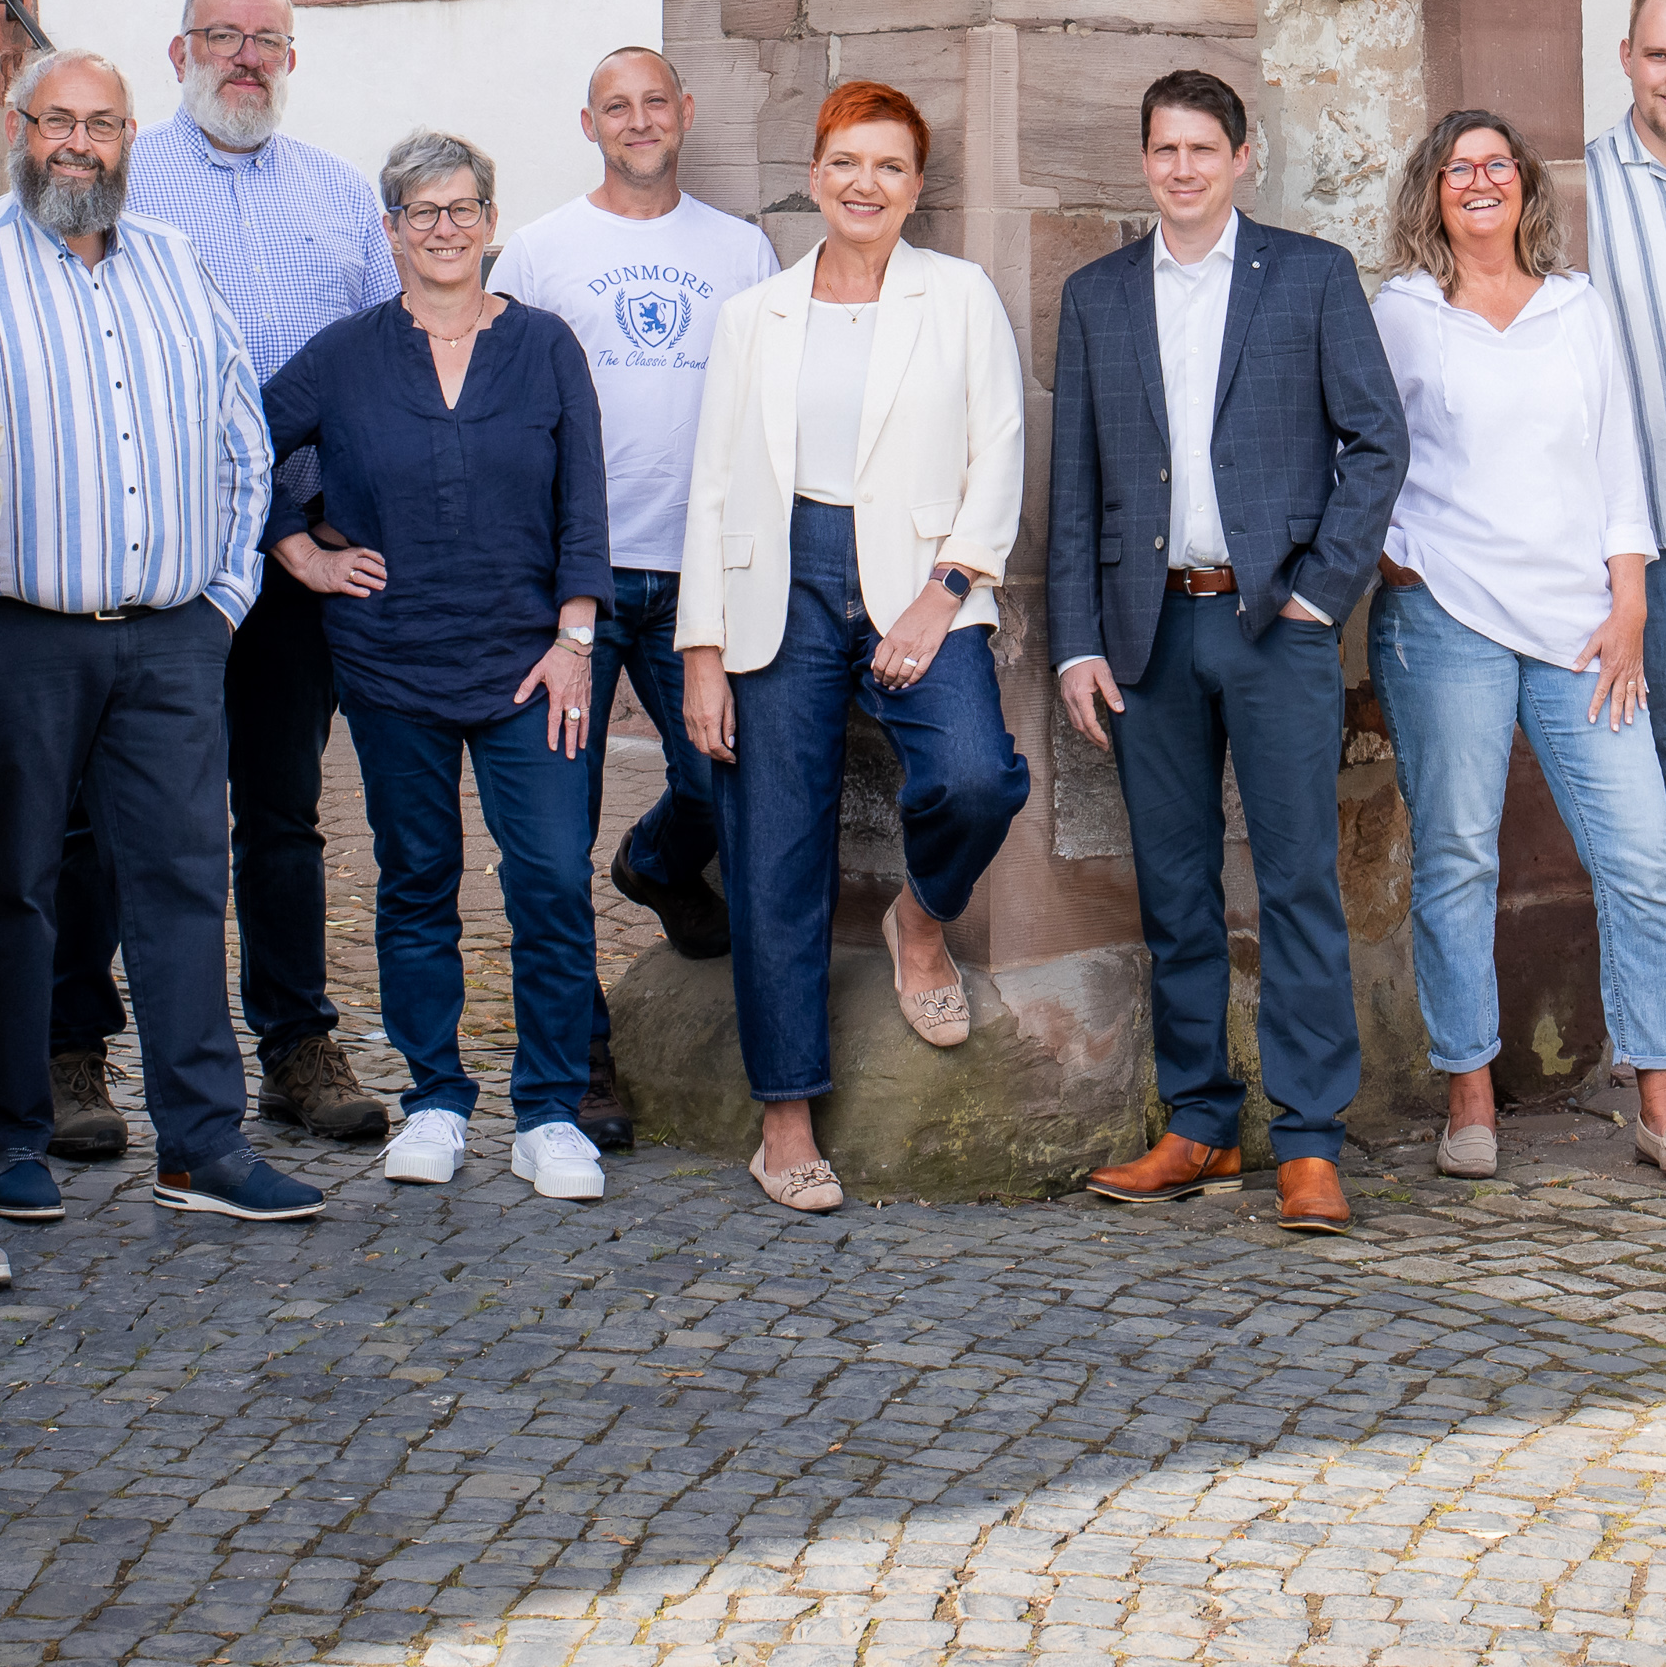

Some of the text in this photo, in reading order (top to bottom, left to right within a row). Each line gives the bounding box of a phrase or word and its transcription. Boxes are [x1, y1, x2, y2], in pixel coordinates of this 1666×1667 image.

[587, 264, 714, 299] DUNMORE
[597, 349, 709, 370] The Classic Brand
